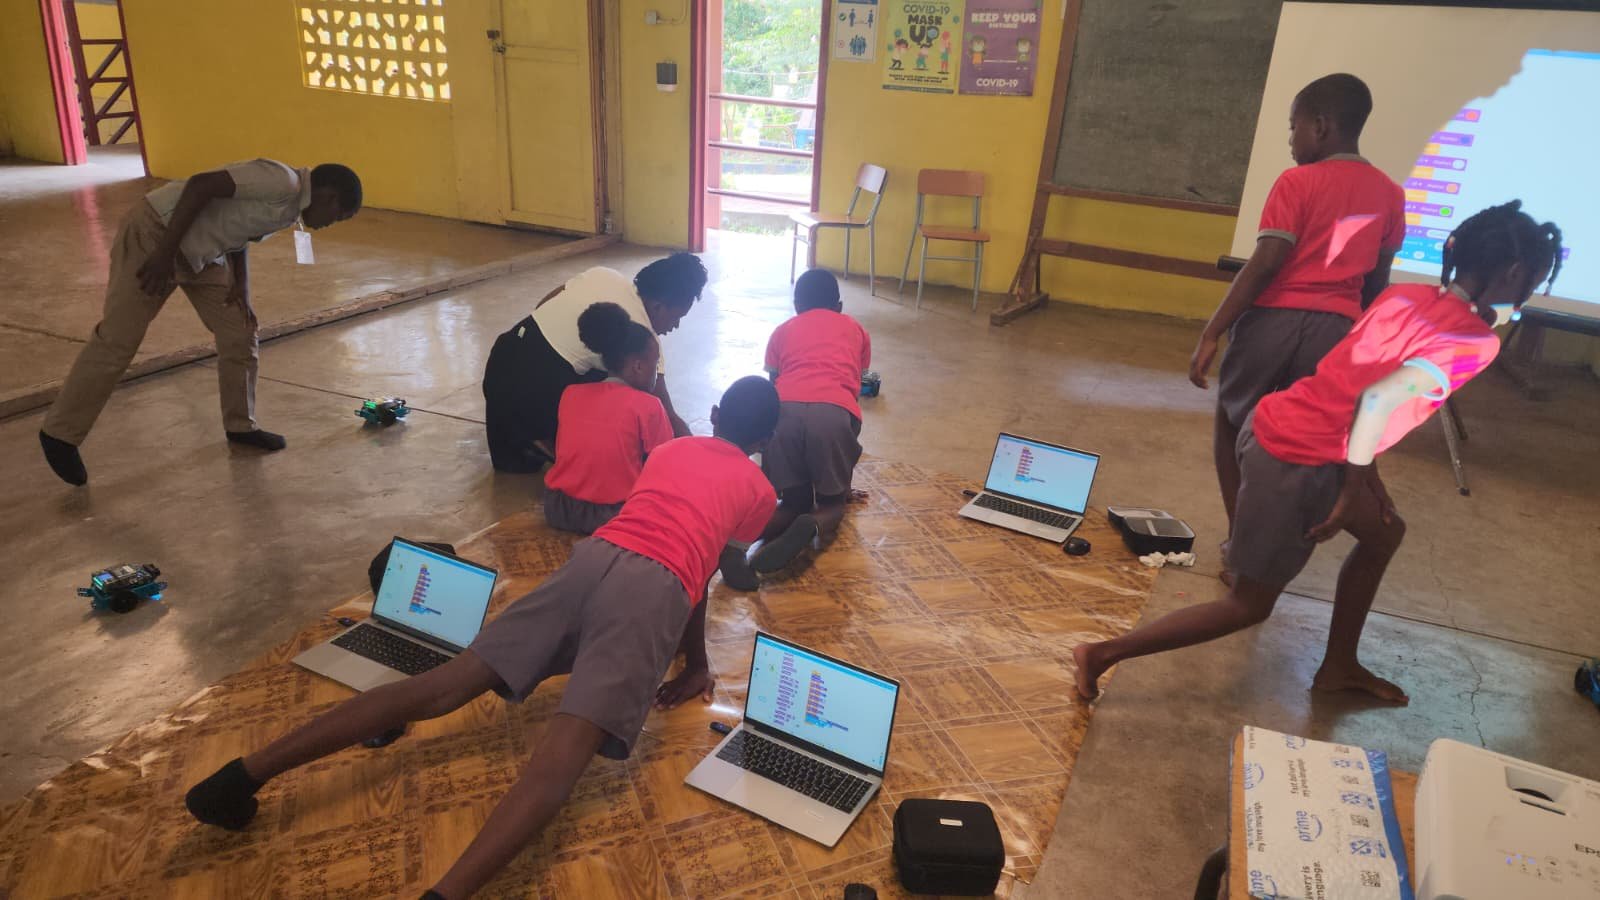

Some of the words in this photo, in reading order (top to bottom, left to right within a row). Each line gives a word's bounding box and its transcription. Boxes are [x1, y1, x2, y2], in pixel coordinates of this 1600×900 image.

[903, 4, 950, 15] COVID-19
[907, 14, 942, 25] MASK
[1003, 13, 1037, 23] YOUR
[909, 25, 940, 44] UP
[976, 78, 1018, 87] COVID-19
[1295, 810, 1314, 842] prime
